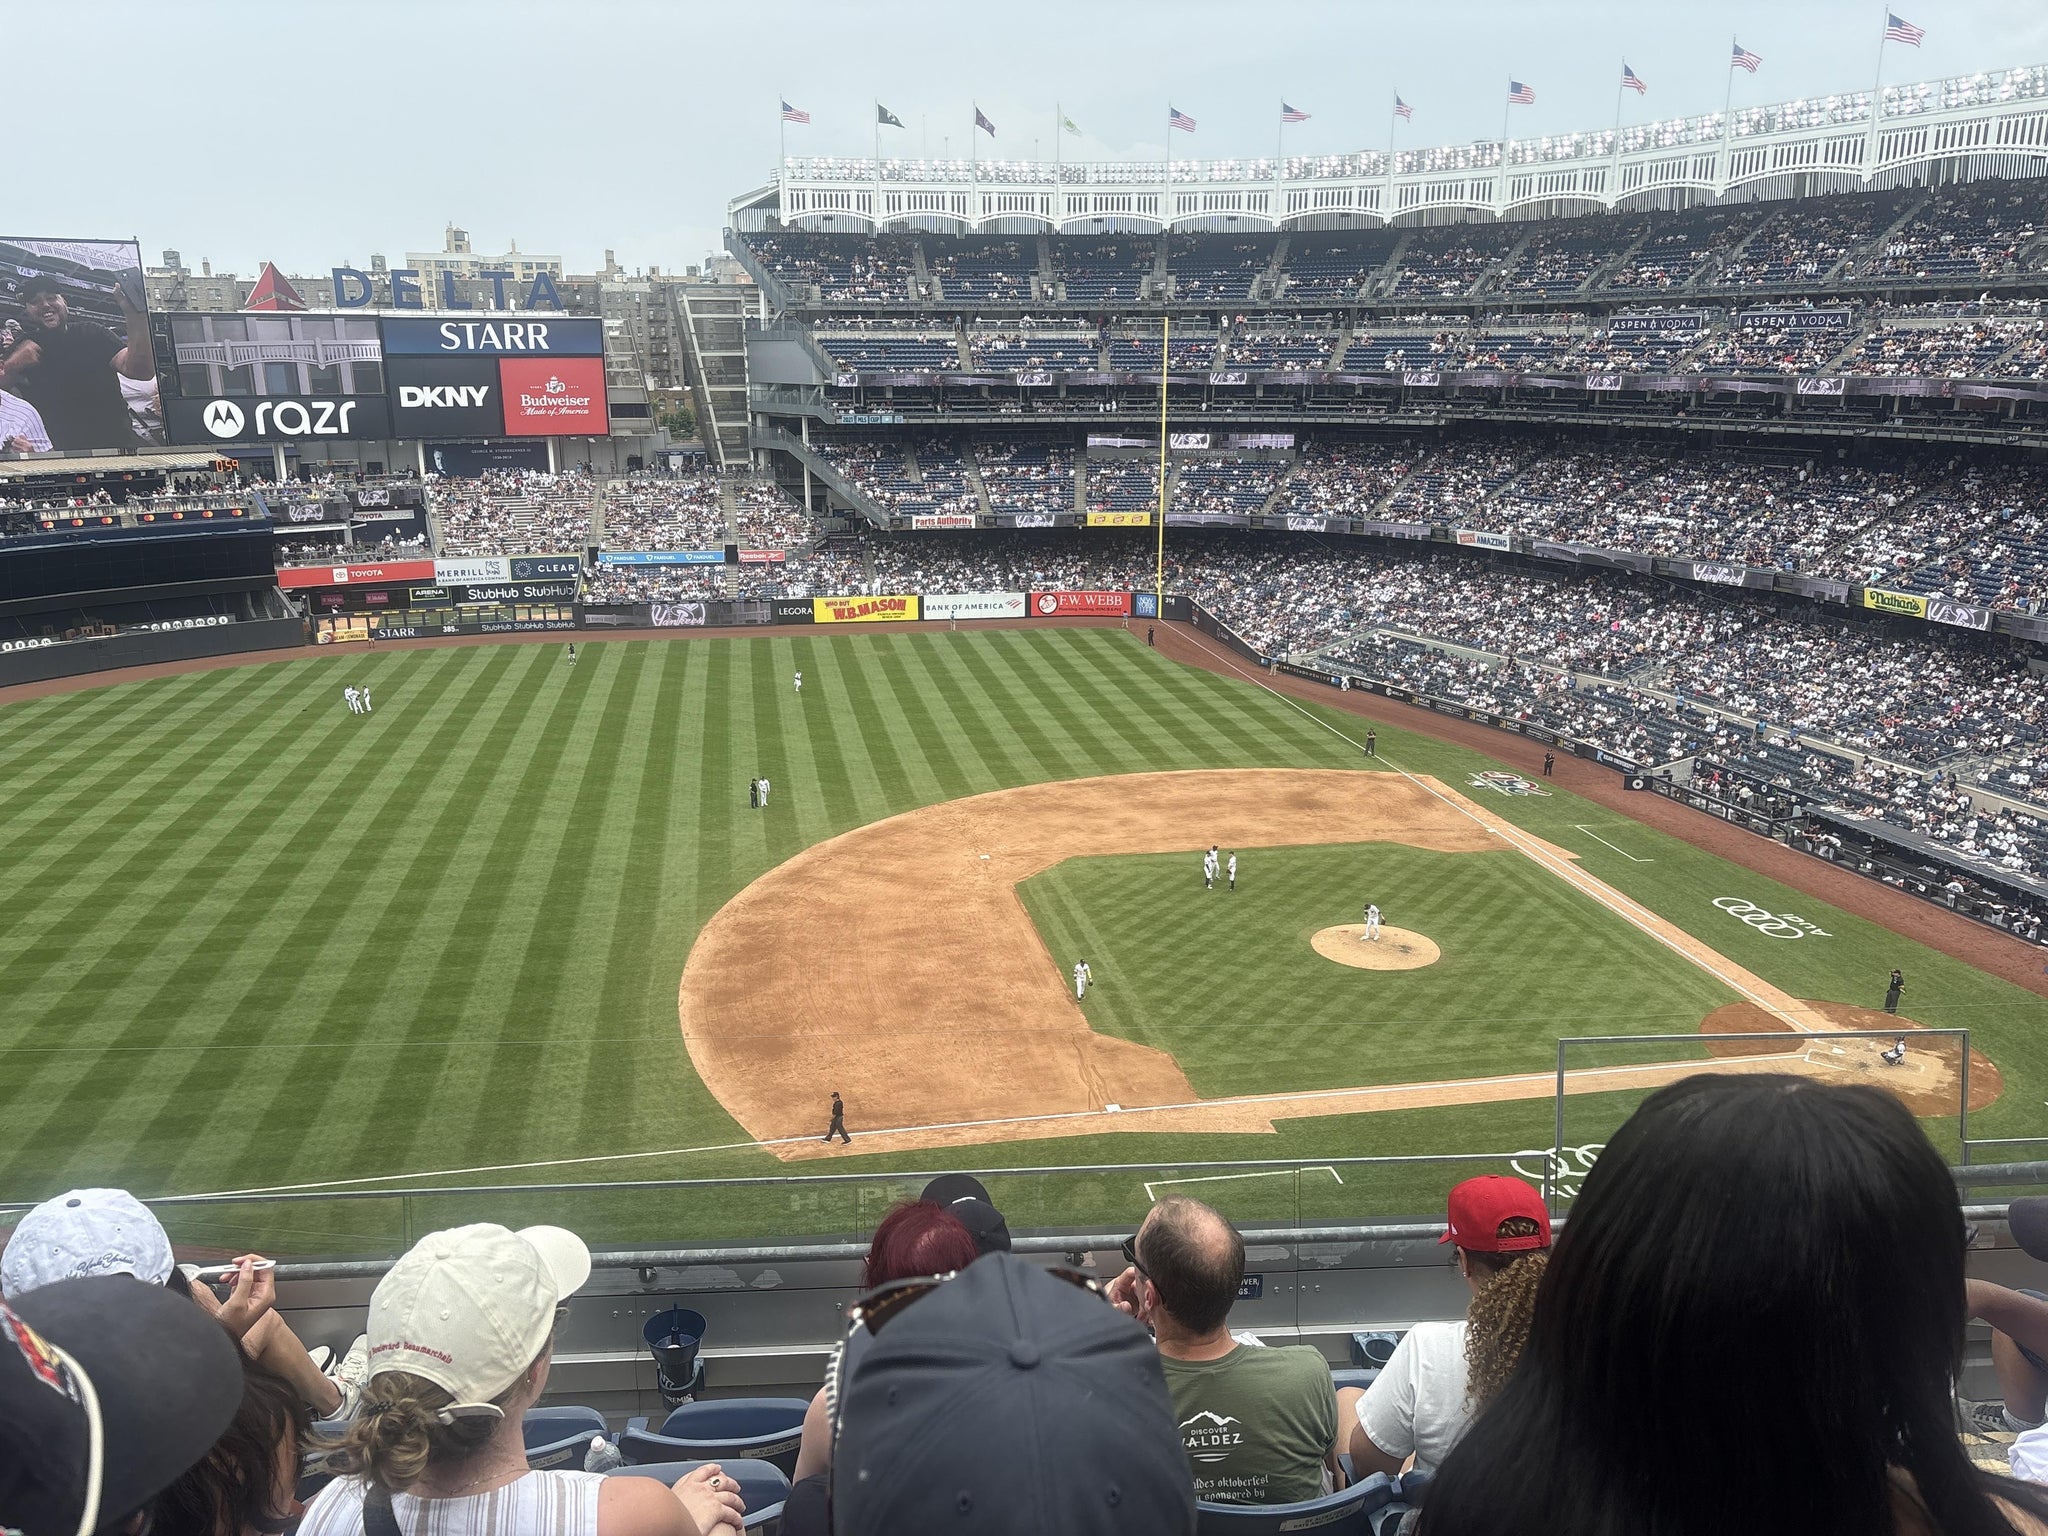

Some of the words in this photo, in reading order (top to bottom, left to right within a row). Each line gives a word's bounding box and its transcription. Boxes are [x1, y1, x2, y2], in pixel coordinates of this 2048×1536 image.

[331, 268, 565, 310] DELTA
[1612, 320, 1647, 329] ASPEN
[1659, 319, 1695, 329] VODKA
[1745, 317, 1786, 327] ASPEN
[1800, 315, 1844, 325] VODKA
[439, 322, 551, 351] STARR
[399, 386, 489, 409] DKNY
[520, 394, 590, 407] Budweiser
[520, 407, 546, 416] Made
[547, 407, 555, 416] of
[555, 407, 589, 415] America
[255, 401, 357, 434] razr
[215, 459, 239, 473] 0:59
[915, 518, 936, 526] Parts
[936, 516, 973, 526] Authority
[1476, 535, 1508, 548] AMAZING
[351, 569, 384, 578] TOYOTA
[437, 569, 484, 578] MERRILL
[537, 563, 576, 573] CLEAR
[468, 589, 519, 600] StubHub
[523, 585, 574, 598] StubHub
[1059, 595, 1081, 606] F.W.
[1084, 595, 1122, 606] WEBB
[1869, 591, 1921, 611] Nathan's
[778, 607, 813, 616] LEGORA
[481, 622, 512, 632] StubHub
[513, 621, 544, 631] StubHub
[546, 621, 576, 630] StubHub
[379, 627, 415, 638] STARR
[1418, 696, 1430, 704] MGM
[1476, 712, 1489, 720] MGM
[1506, 720, 1520, 729] MGM
[1563, 740, 1576, 749] MGM
[1190, 1426, 1228, 1436] DISCOVER
[1217, 1474, 1269, 1488] oktoberfest
[1204, 1488, 1252, 1501] sponsored
[1254, 1488, 1265, 1498] by
